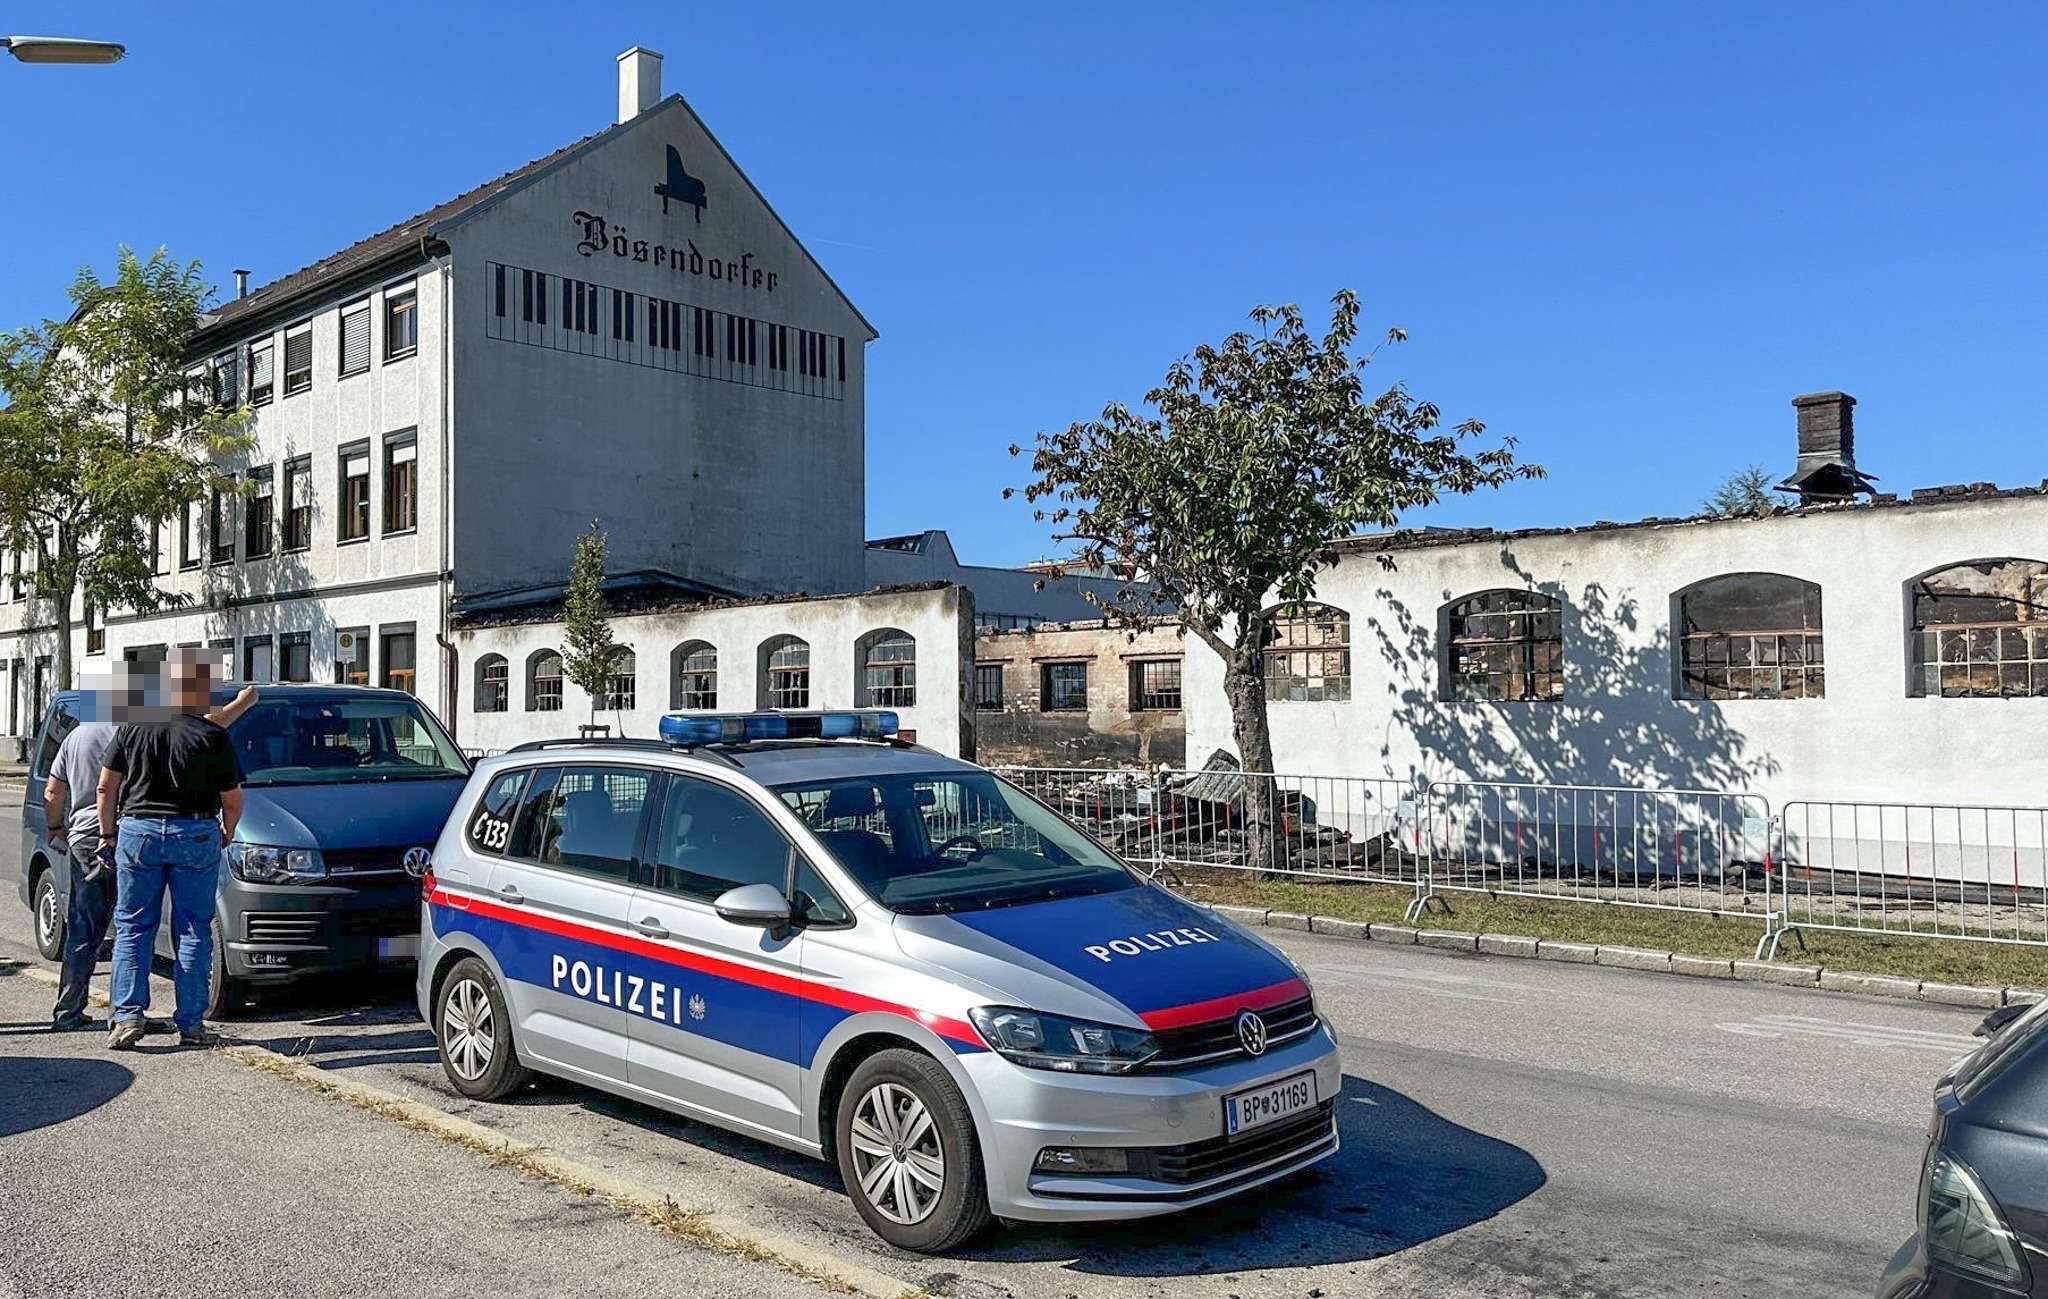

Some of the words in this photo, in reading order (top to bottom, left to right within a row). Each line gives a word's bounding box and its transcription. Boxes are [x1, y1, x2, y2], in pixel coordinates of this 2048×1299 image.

[573, 211, 778, 291] Bösendorfer
[483, 819, 509, 849] 133
[1084, 927, 1220, 962] POLIZEI
[552, 954, 681, 1025] POLIZEI
[1271, 1081, 1308, 1114] 31169
